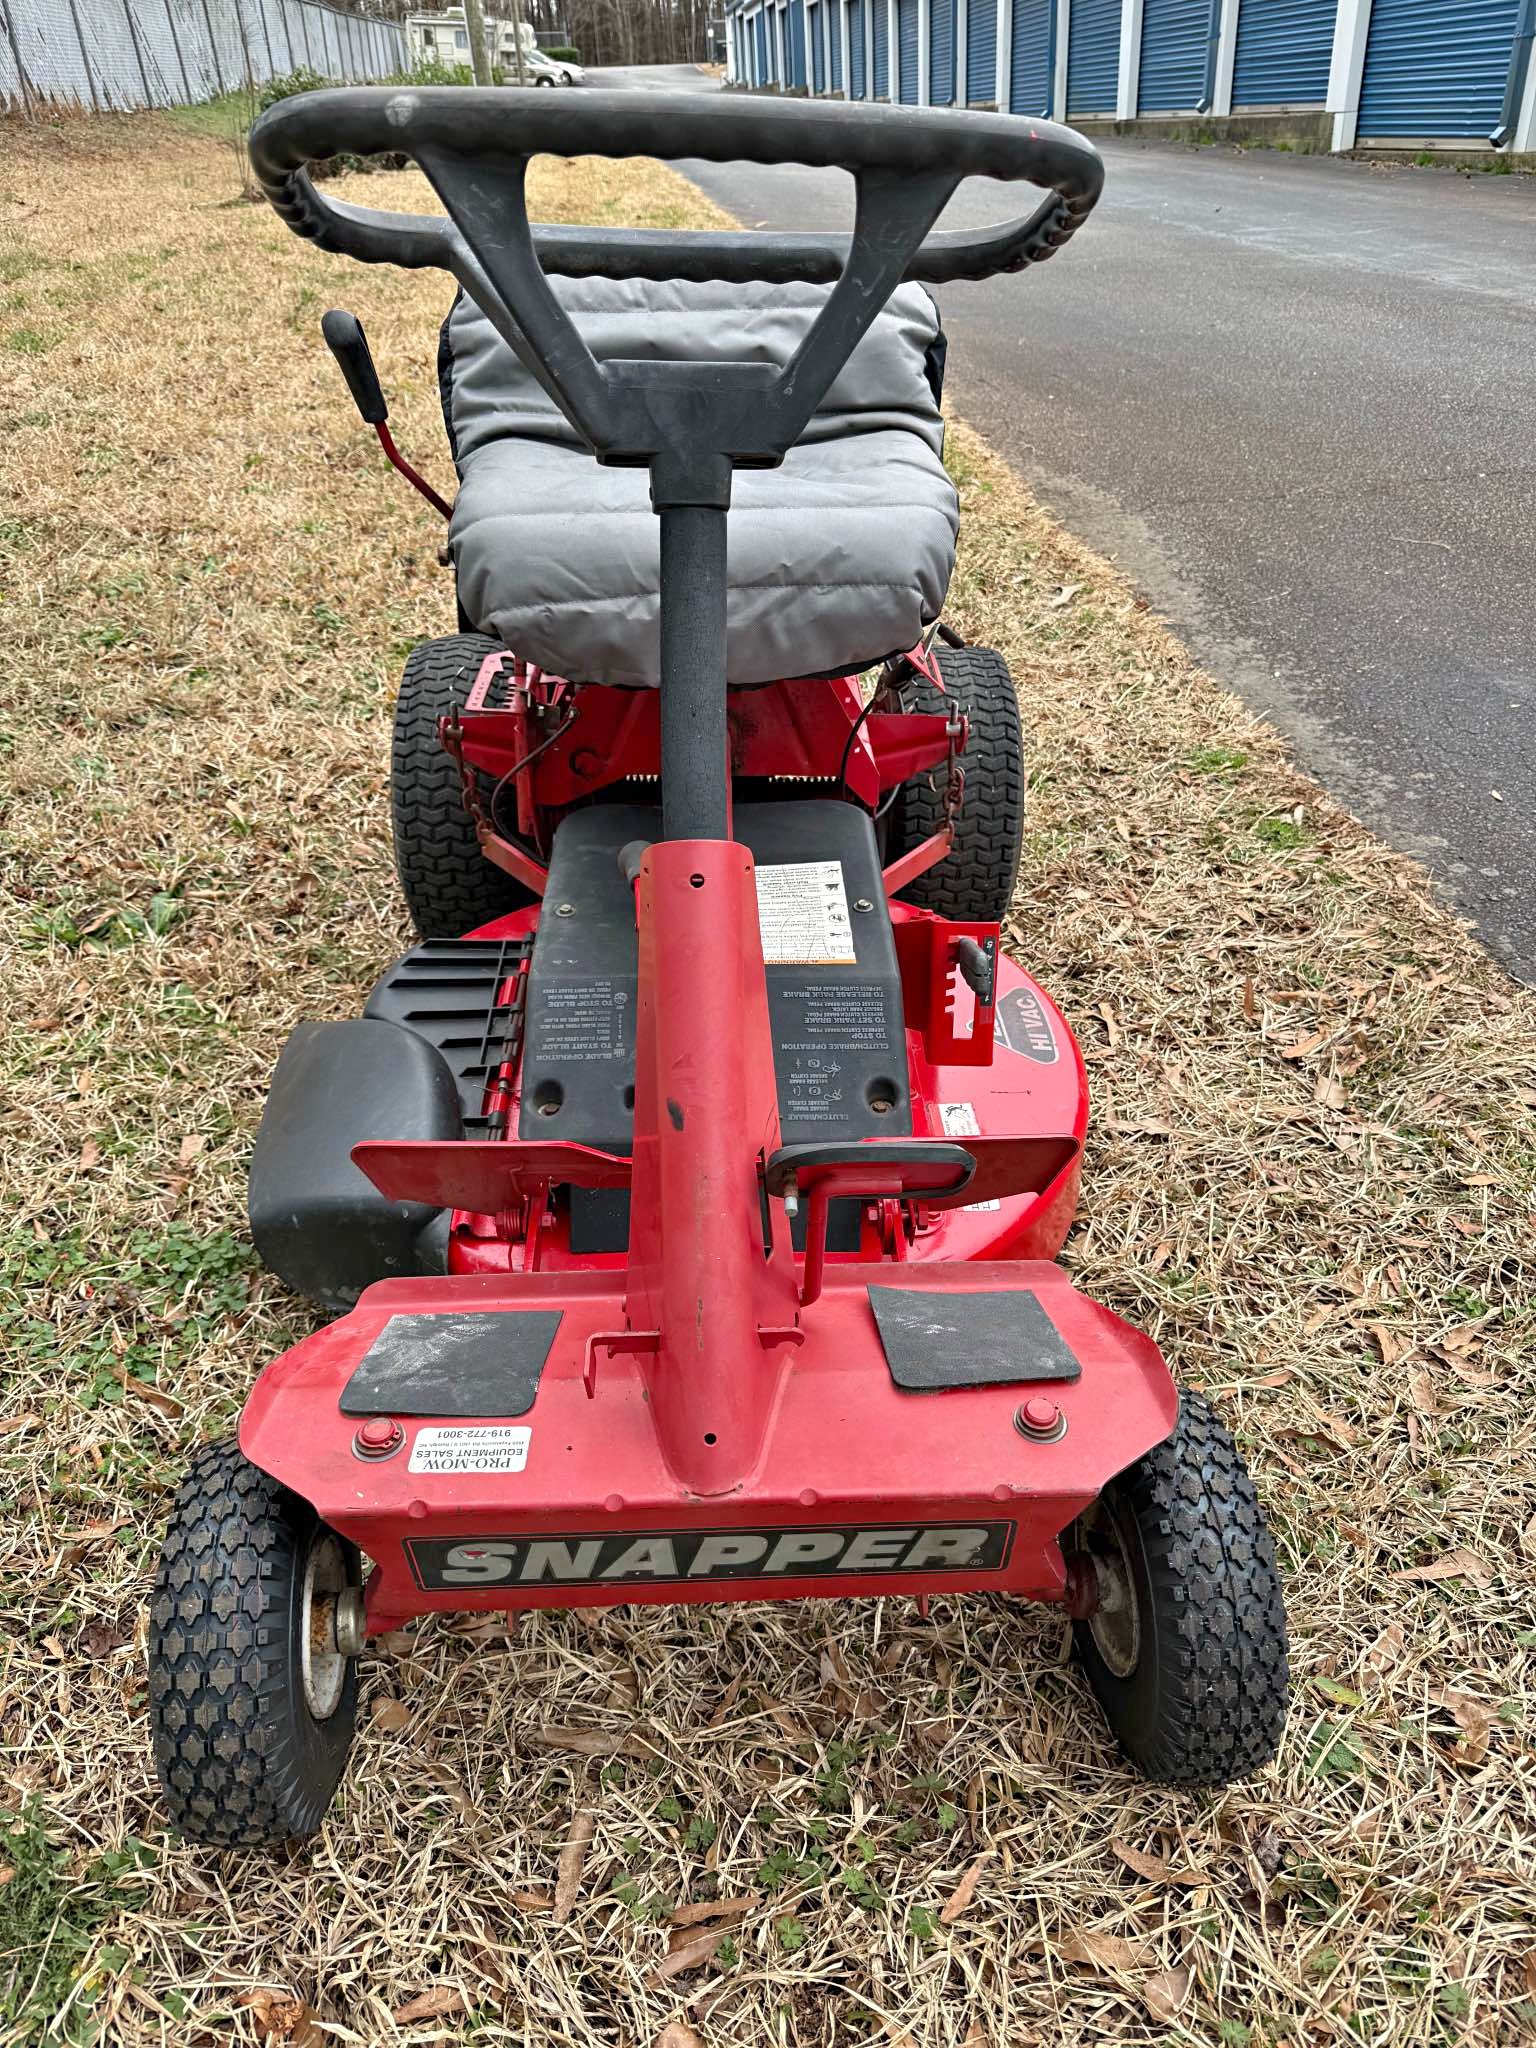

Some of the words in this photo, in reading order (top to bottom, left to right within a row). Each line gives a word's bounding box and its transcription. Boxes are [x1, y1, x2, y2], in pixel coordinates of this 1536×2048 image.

[1028, 1033, 1052, 1051] HI
[437, 1429, 511, 1438] 919-772-3001
[416, 1450, 453, 1458] SALES
[456, 1448, 523, 1457] EQUIPMENT
[423, 1458, 511, 1470] PRO-MOW
[441, 1527, 989, 1583] SNAPPER
